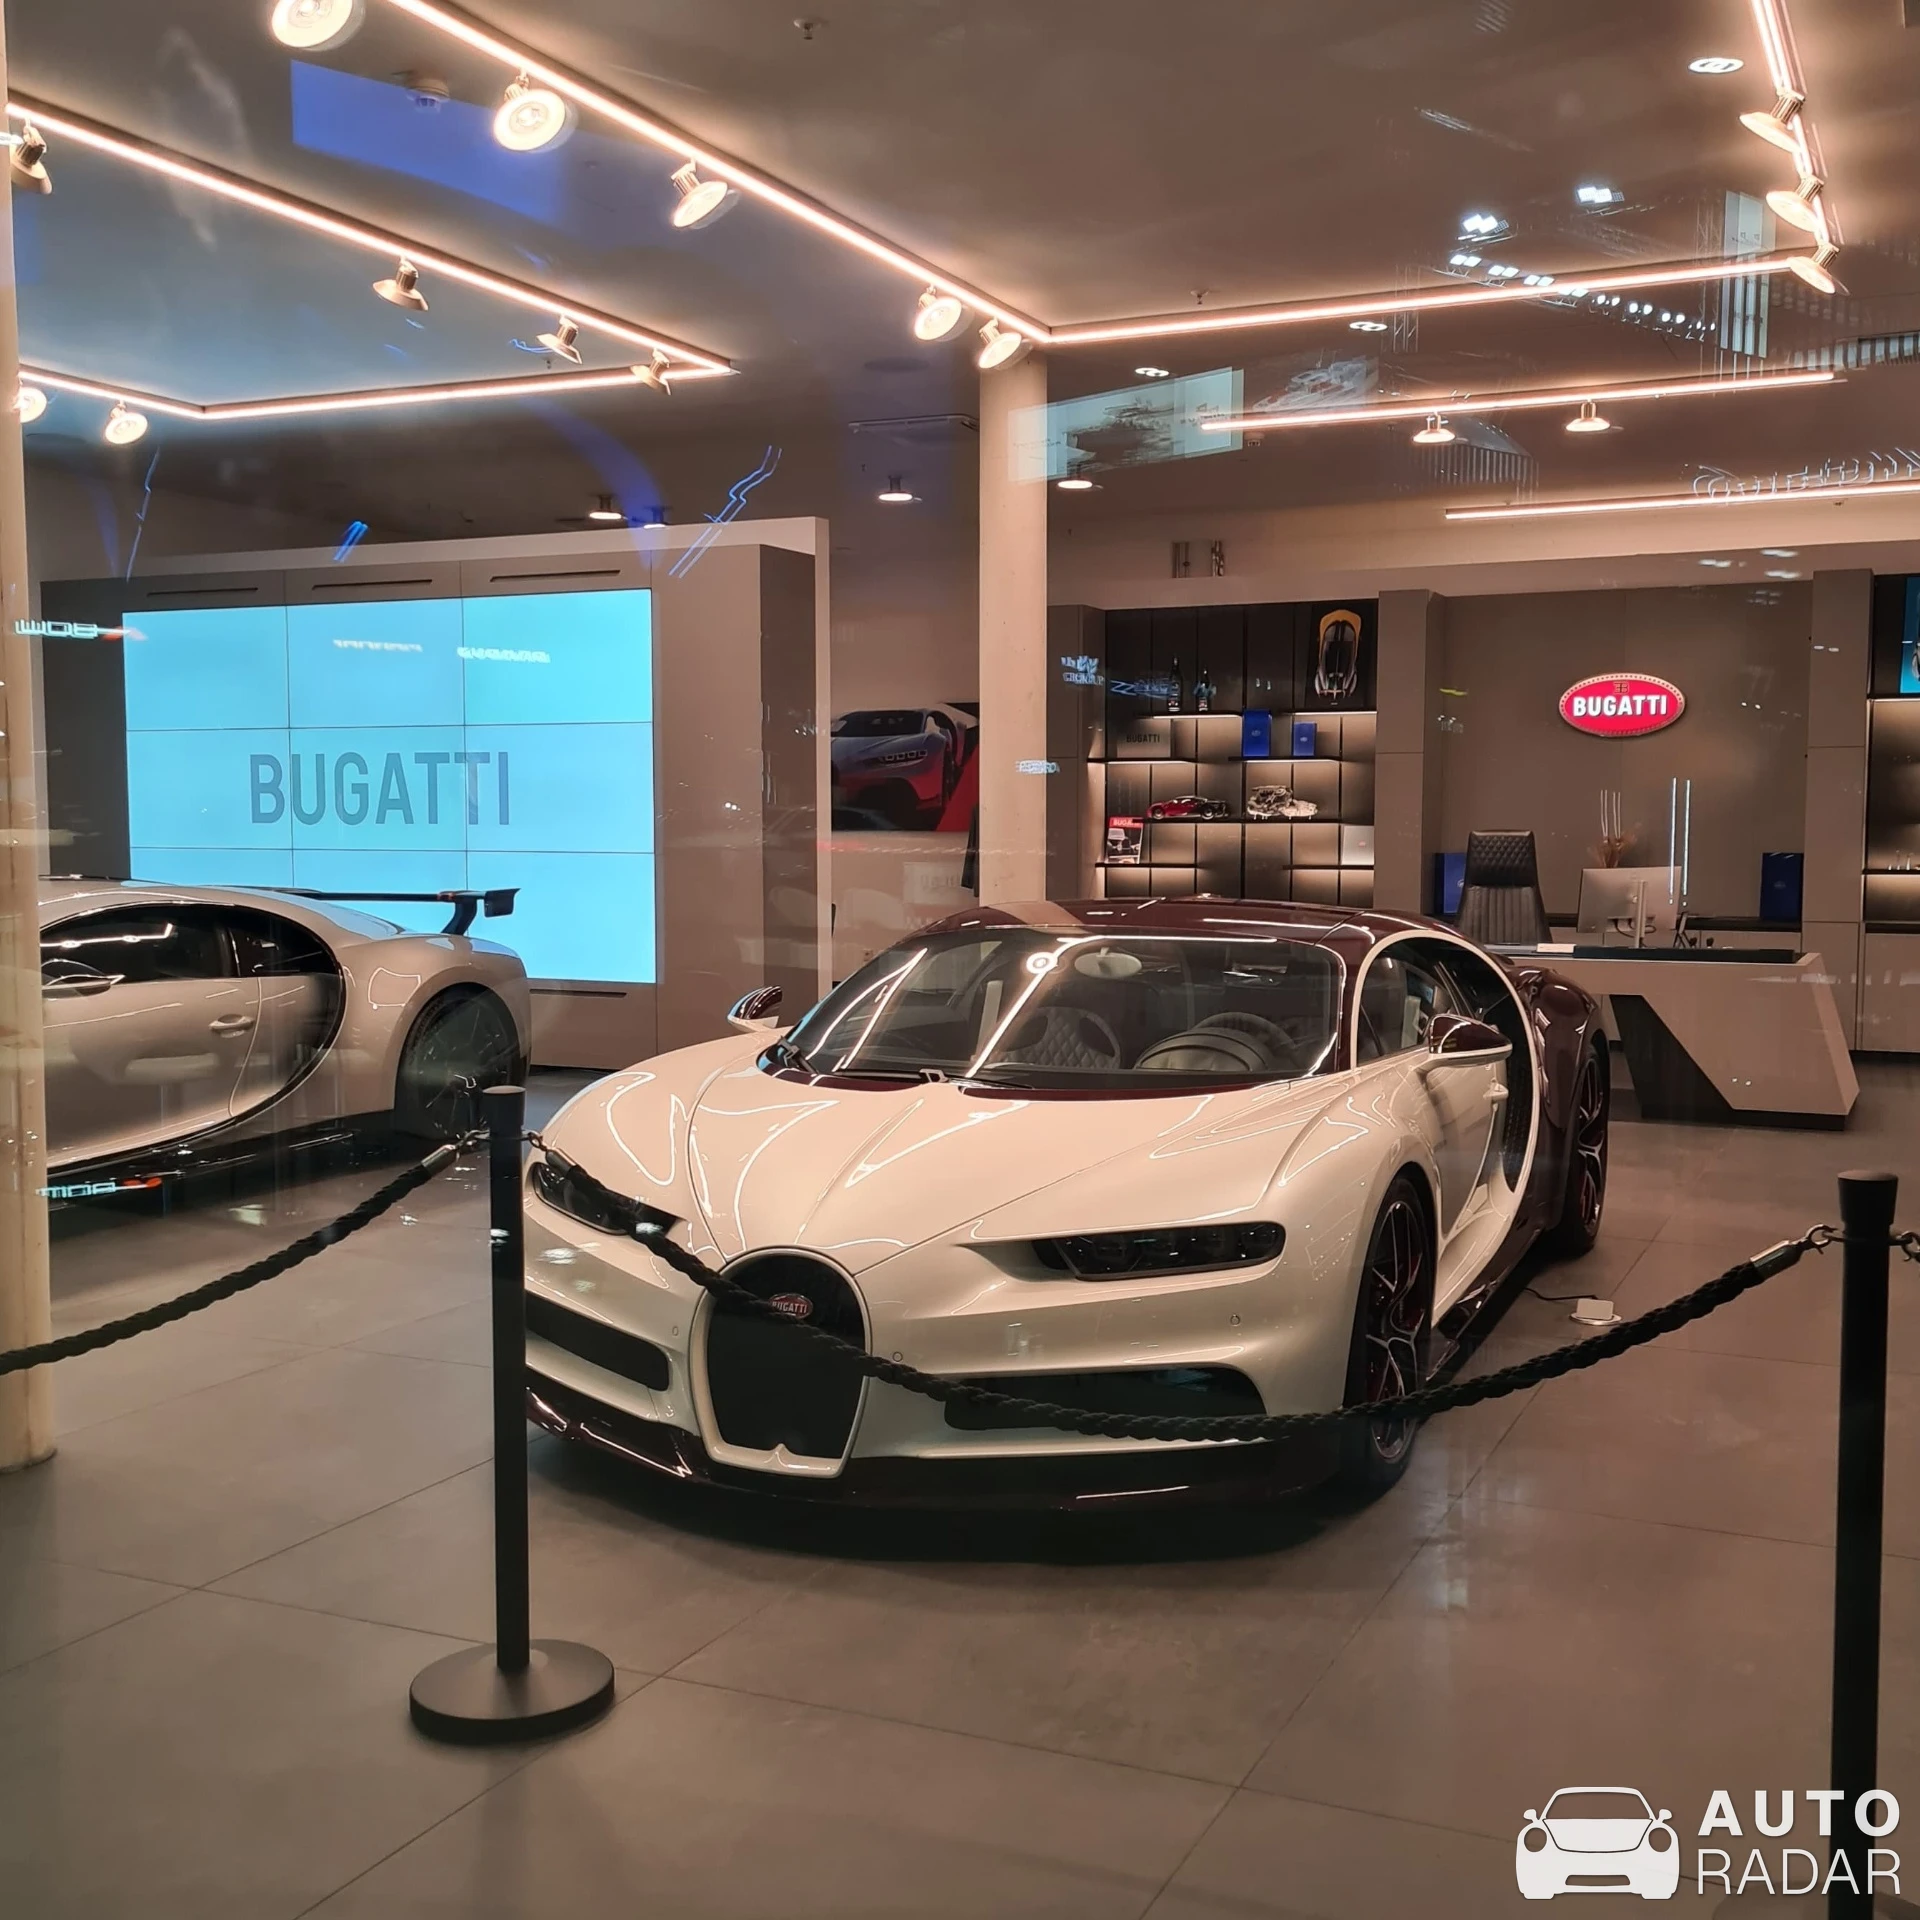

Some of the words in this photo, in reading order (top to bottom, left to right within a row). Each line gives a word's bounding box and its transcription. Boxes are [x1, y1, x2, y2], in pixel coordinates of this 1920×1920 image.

[1573, 695, 1667, 717] BUGATTI
[1126, 733, 1160, 743] BUGATTI
[250, 751, 509, 826] BUGATTI
